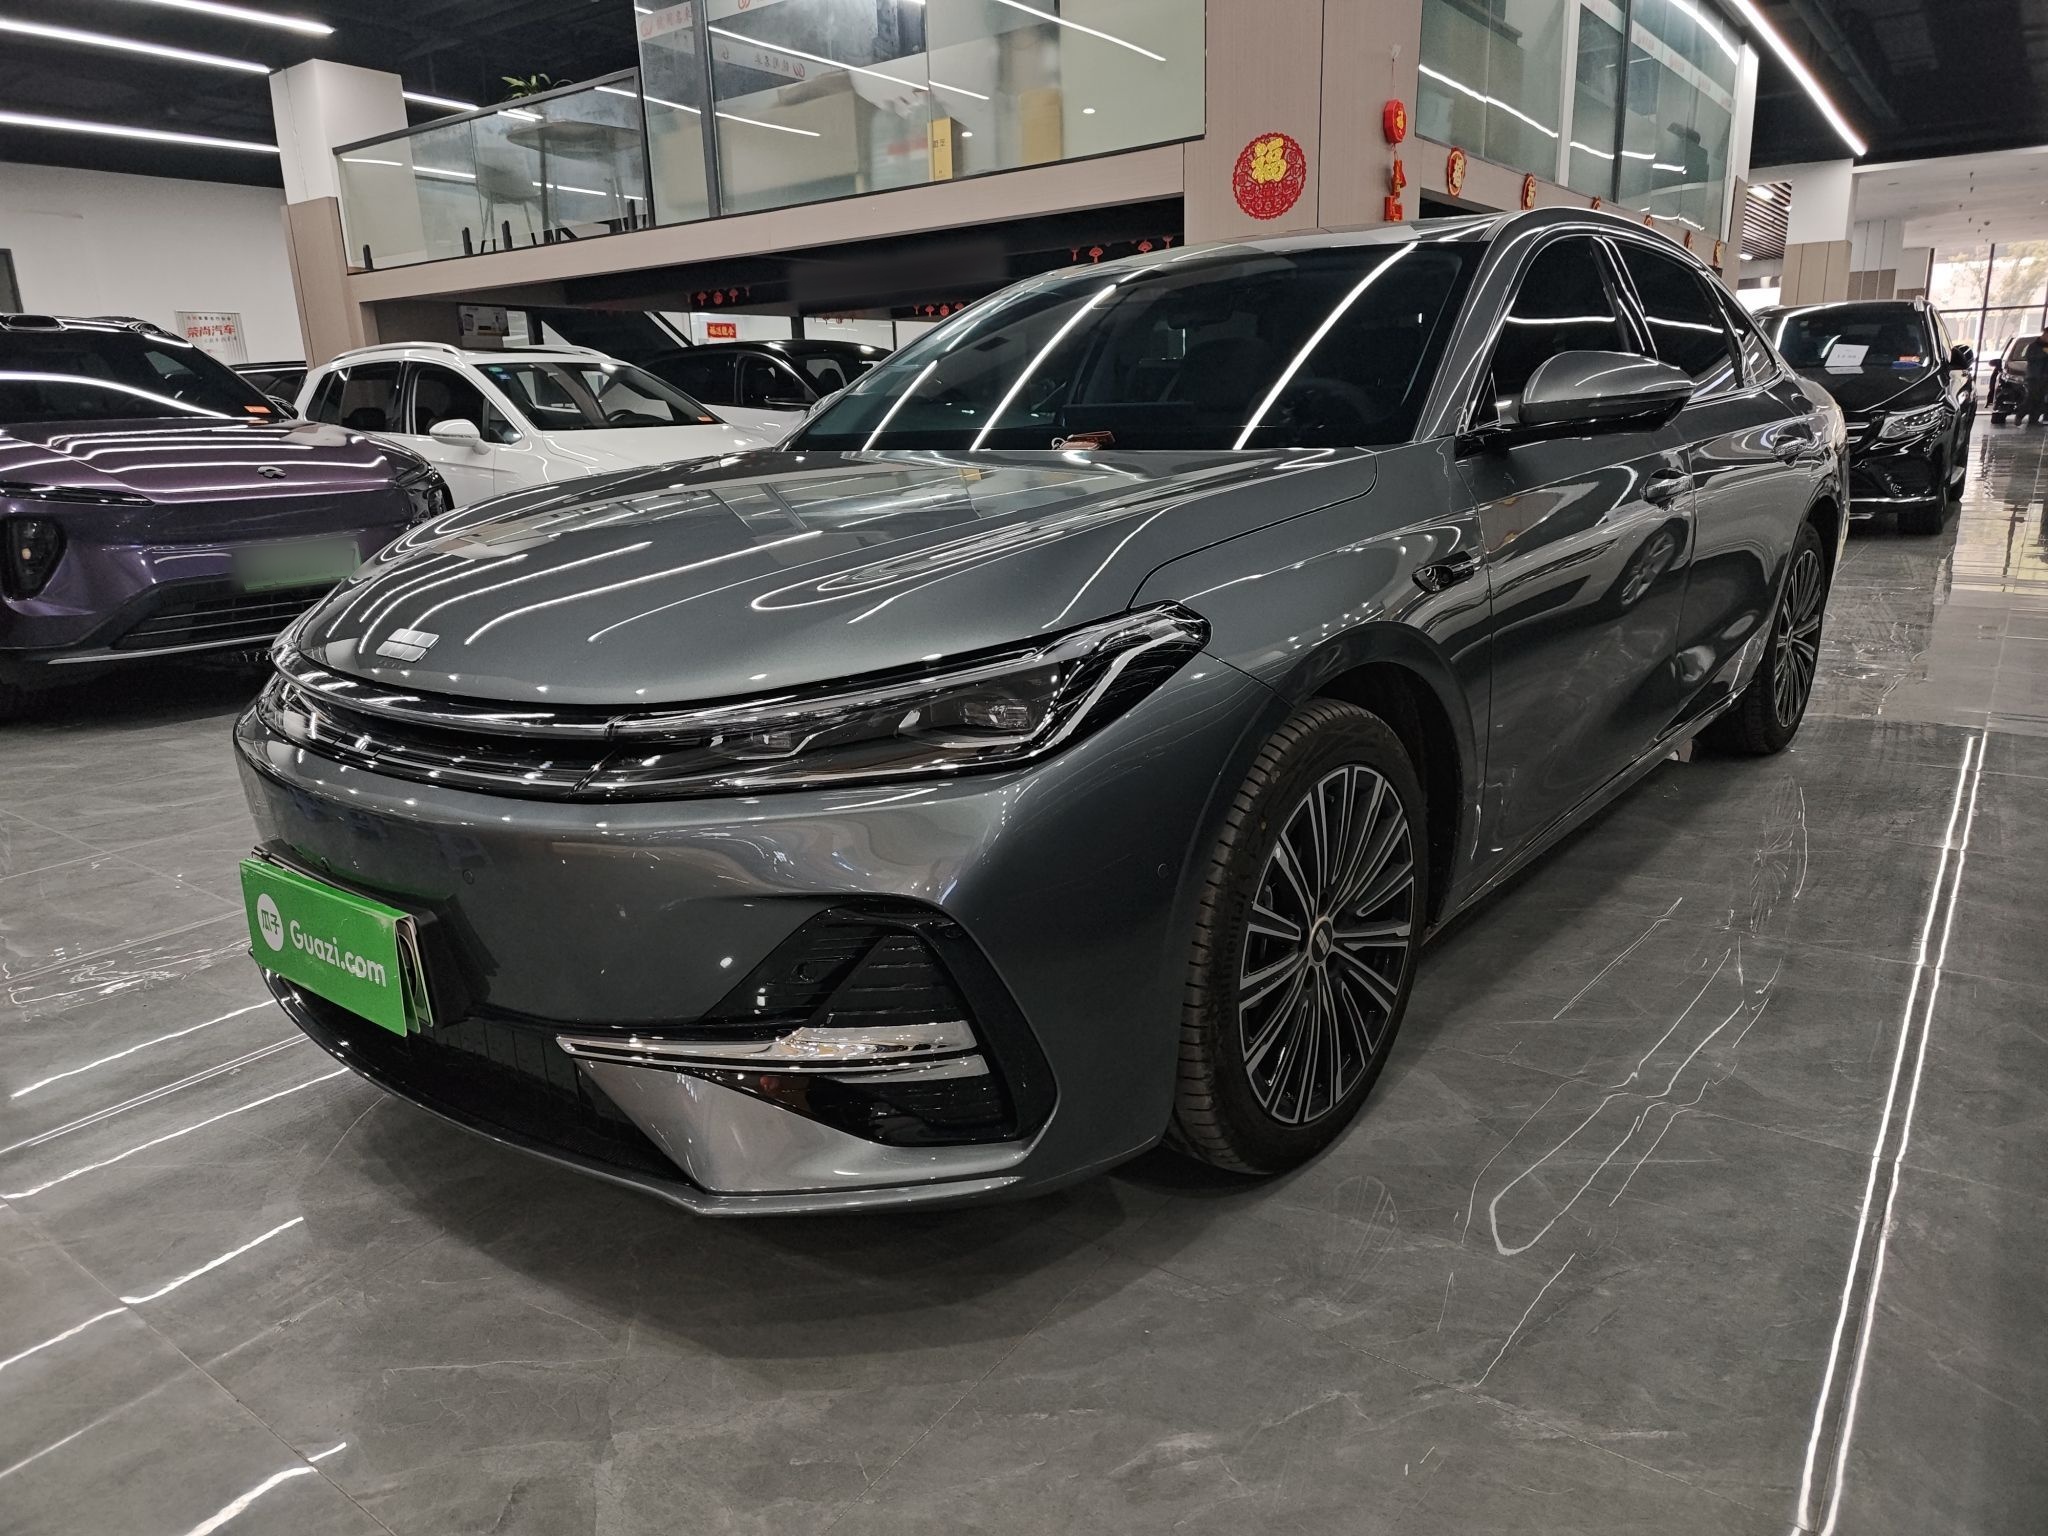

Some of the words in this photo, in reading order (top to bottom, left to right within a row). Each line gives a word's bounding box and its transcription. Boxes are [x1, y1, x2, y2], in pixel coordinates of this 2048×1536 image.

[1251, 137, 1288, 184] 福
[261, 909, 281, 935] 瓜子
[290, 920, 387, 988] Guazi.com
